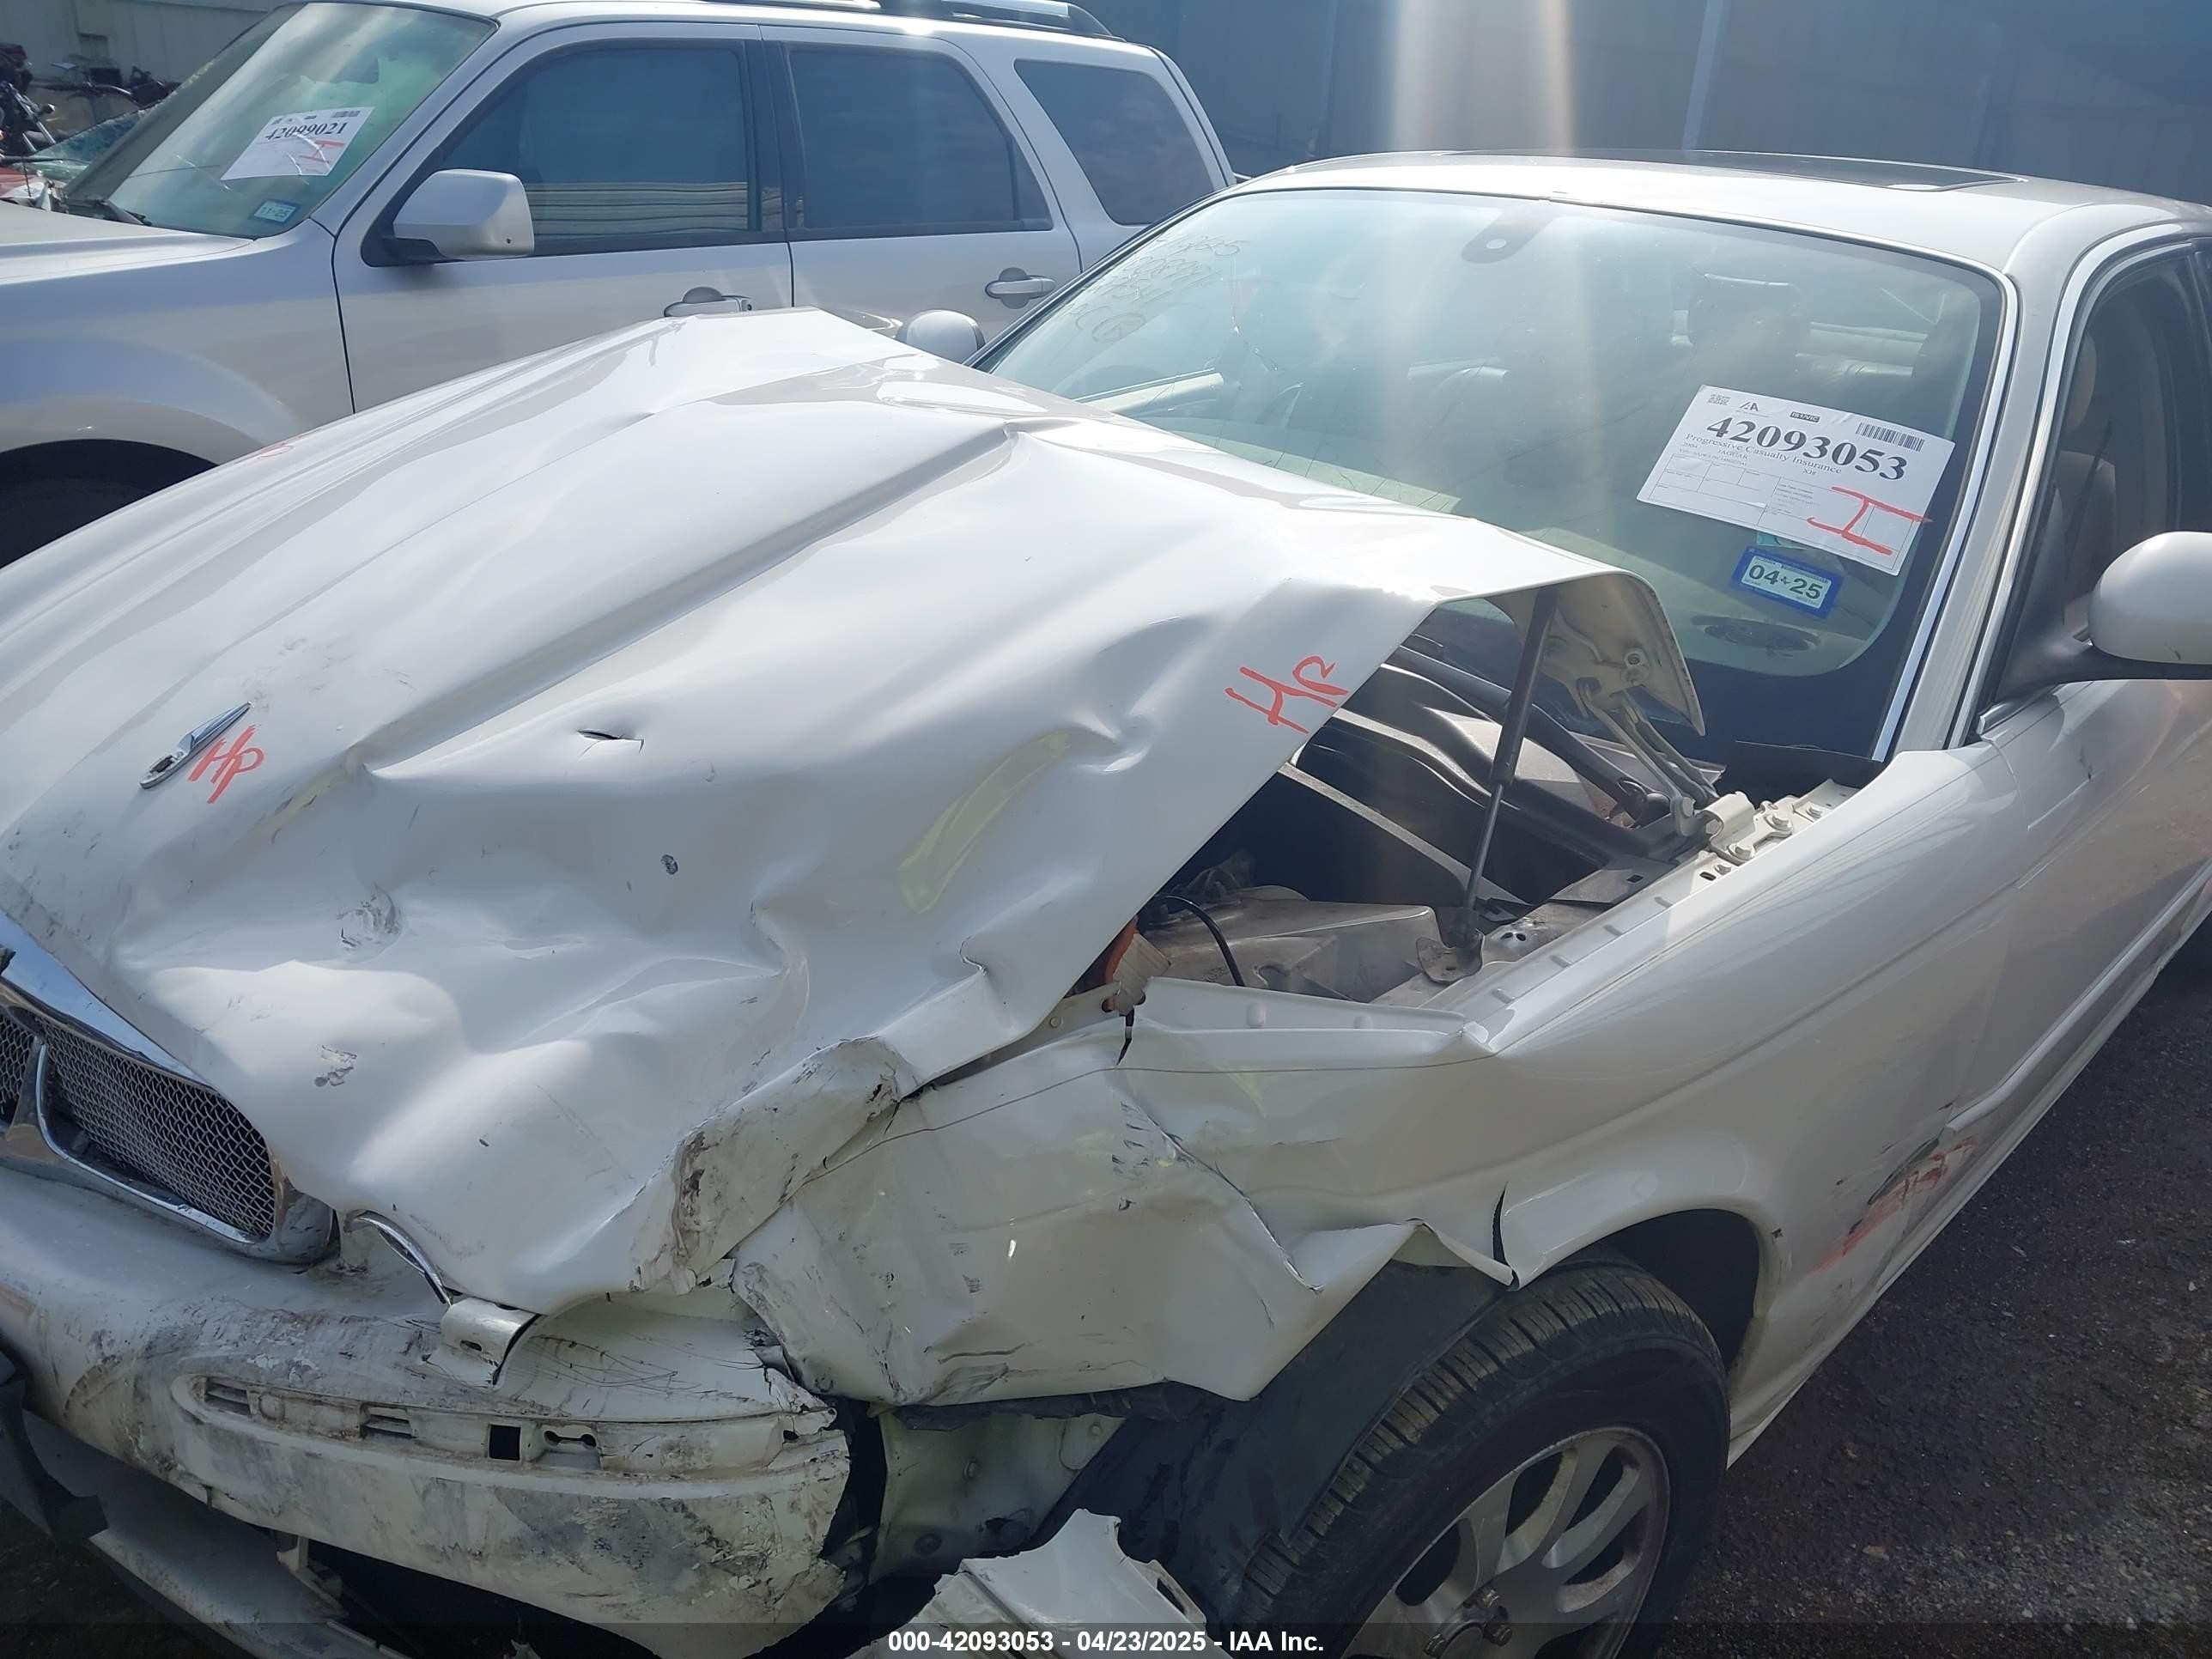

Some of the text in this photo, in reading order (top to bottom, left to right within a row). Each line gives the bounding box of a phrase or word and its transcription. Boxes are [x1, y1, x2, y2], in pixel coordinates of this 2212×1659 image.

[265, 121, 348, 140] 42099021
[1685, 433, 1744, 452] Progressive
[1745, 445, 1790, 462] Casualty
[1792, 456, 1843, 474] Insurance
[1706, 416, 1908, 481] 42093053
[1717, 449, 1748, 461] JAGUAR
[1748, 564, 1780, 585] 04
[1789, 578, 1823, 599] 25
